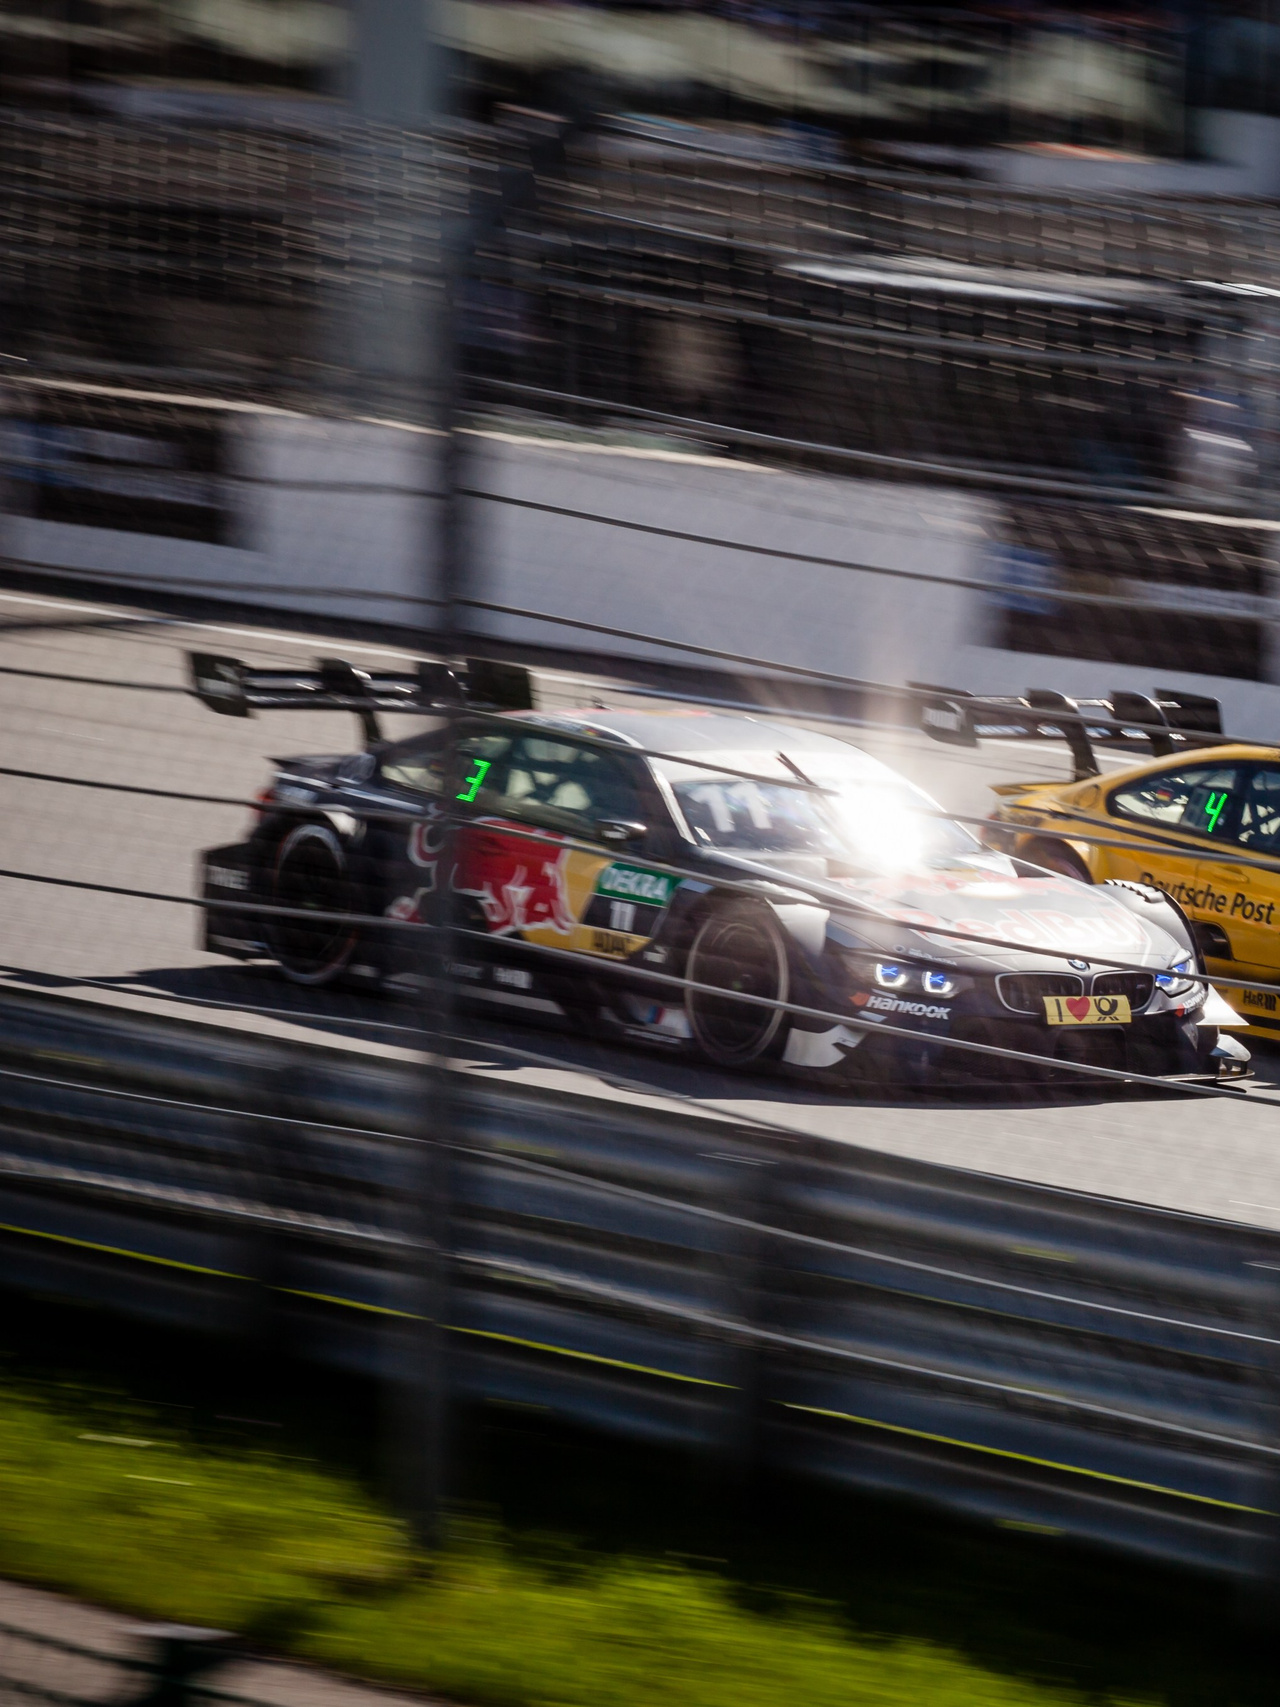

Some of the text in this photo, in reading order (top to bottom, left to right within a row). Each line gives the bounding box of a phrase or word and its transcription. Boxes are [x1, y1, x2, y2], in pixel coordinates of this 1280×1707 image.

[455, 758, 492, 803] 3
[687, 782, 773, 832] 11
[1204, 791, 1228, 833] 4
[600, 866, 670, 901] DEKRA
[610, 900, 637, 932] 11
[1230, 891, 1276, 925] Post
